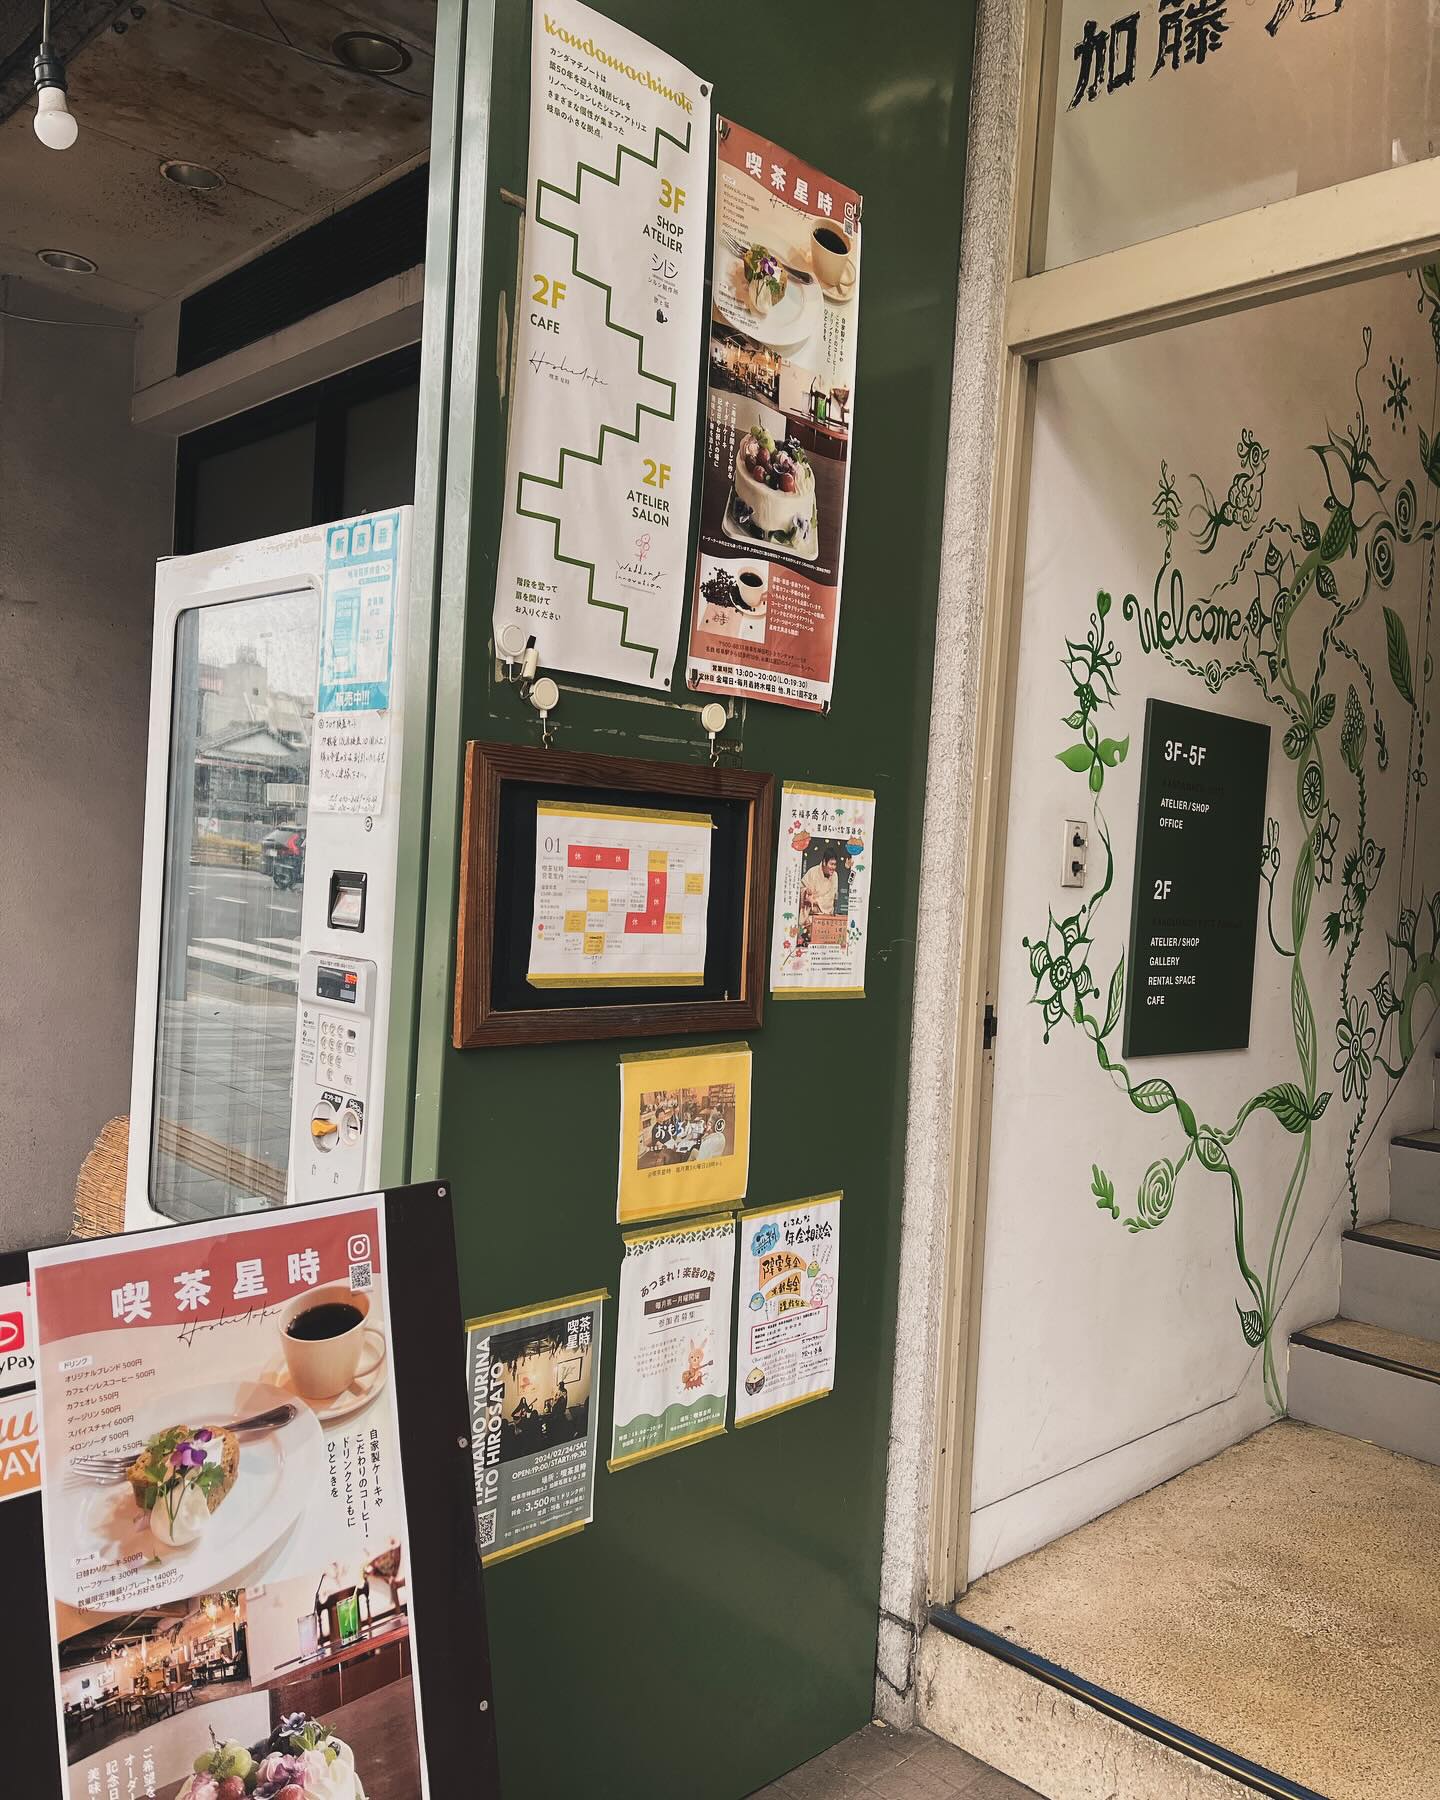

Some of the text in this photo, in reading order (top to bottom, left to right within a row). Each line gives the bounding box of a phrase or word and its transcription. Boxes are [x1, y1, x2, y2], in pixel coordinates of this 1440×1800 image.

[550, 47, 607, 83] カンダマチノートは
[547, 90, 625, 136] さまざまな個性が集まった
[745, 151, 833, 216] 喫茶星時
[658, 178, 686, 214] 3F
[656, 215, 684, 237] SHOP
[642, 224, 683, 254] ATELIER
[531, 274, 567, 309] 2F
[530, 313, 560, 334] CAFE
[641, 458, 672, 489] 2F
[626, 489, 670, 513] ATELIER
[631, 506, 670, 528] SALON
[516, 577, 558, 593] 階段を登って
[515, 591, 551, 606] 扉を開けて
[514, 605, 561, 622] お入りください
[1123, 568, 1242, 654] Welcome
[1164, 740, 1207, 766] 3F-5F
[1159, 817, 1184, 829] OFFICE
[544, 836, 560, 854] 01
[1153, 879, 1173, 900] 2F
[1149, 956, 1180, 966] GALLERY
[1148, 975, 1196, 986] RENTAL SPACE
[1146, 995, 1165, 1006] CAFE
[785, 1221, 833, 1246] 年金相談会
[762, 1254, 801, 1280] 障害年金
[111, 1248, 321, 1324] 喫茶星時
[567, 1314, 591, 1334] 喫茶
[566, 1331, 591, 1350] 星時
[63, 1357, 88, 1369] ドリンク
[64, 1358, 143, 1383] オリジナルブレンド 500円
[65, 1368, 156, 1397] カフェインレスコーヒー 500円
[473, 1336, 491, 1417] YURINA
[66, 1391, 119, 1411] カフェオレ 550円
[67, 1404, 121, 1425] ダージリン 500円
[68, 1415, 134, 1439] スパイスチャイ 600円
[484, 1361, 504, 1504] ITO HIROSATO
[69, 1429, 129, 1452] メロンソーダ 500円
[122, 1440, 143, 1451] 550円
[534, 1441, 587, 1465] 2024/02/24/SAT
[327, 1441, 339, 1498] ひとときを
[370, 1429, 383, 1508] 自家製ケーキや
[343, 1436, 356, 1528] ドリンクとともに
[76, 1554, 95, 1565] ケーキ
[76, 1552, 143, 1579] 日替わりケーキ 500円
[77, 1567, 138, 1593] ハーフケーキ 300円
[153, 1568, 177, 1580] 1400円
[87, 1767, 101, 1800] 美味
